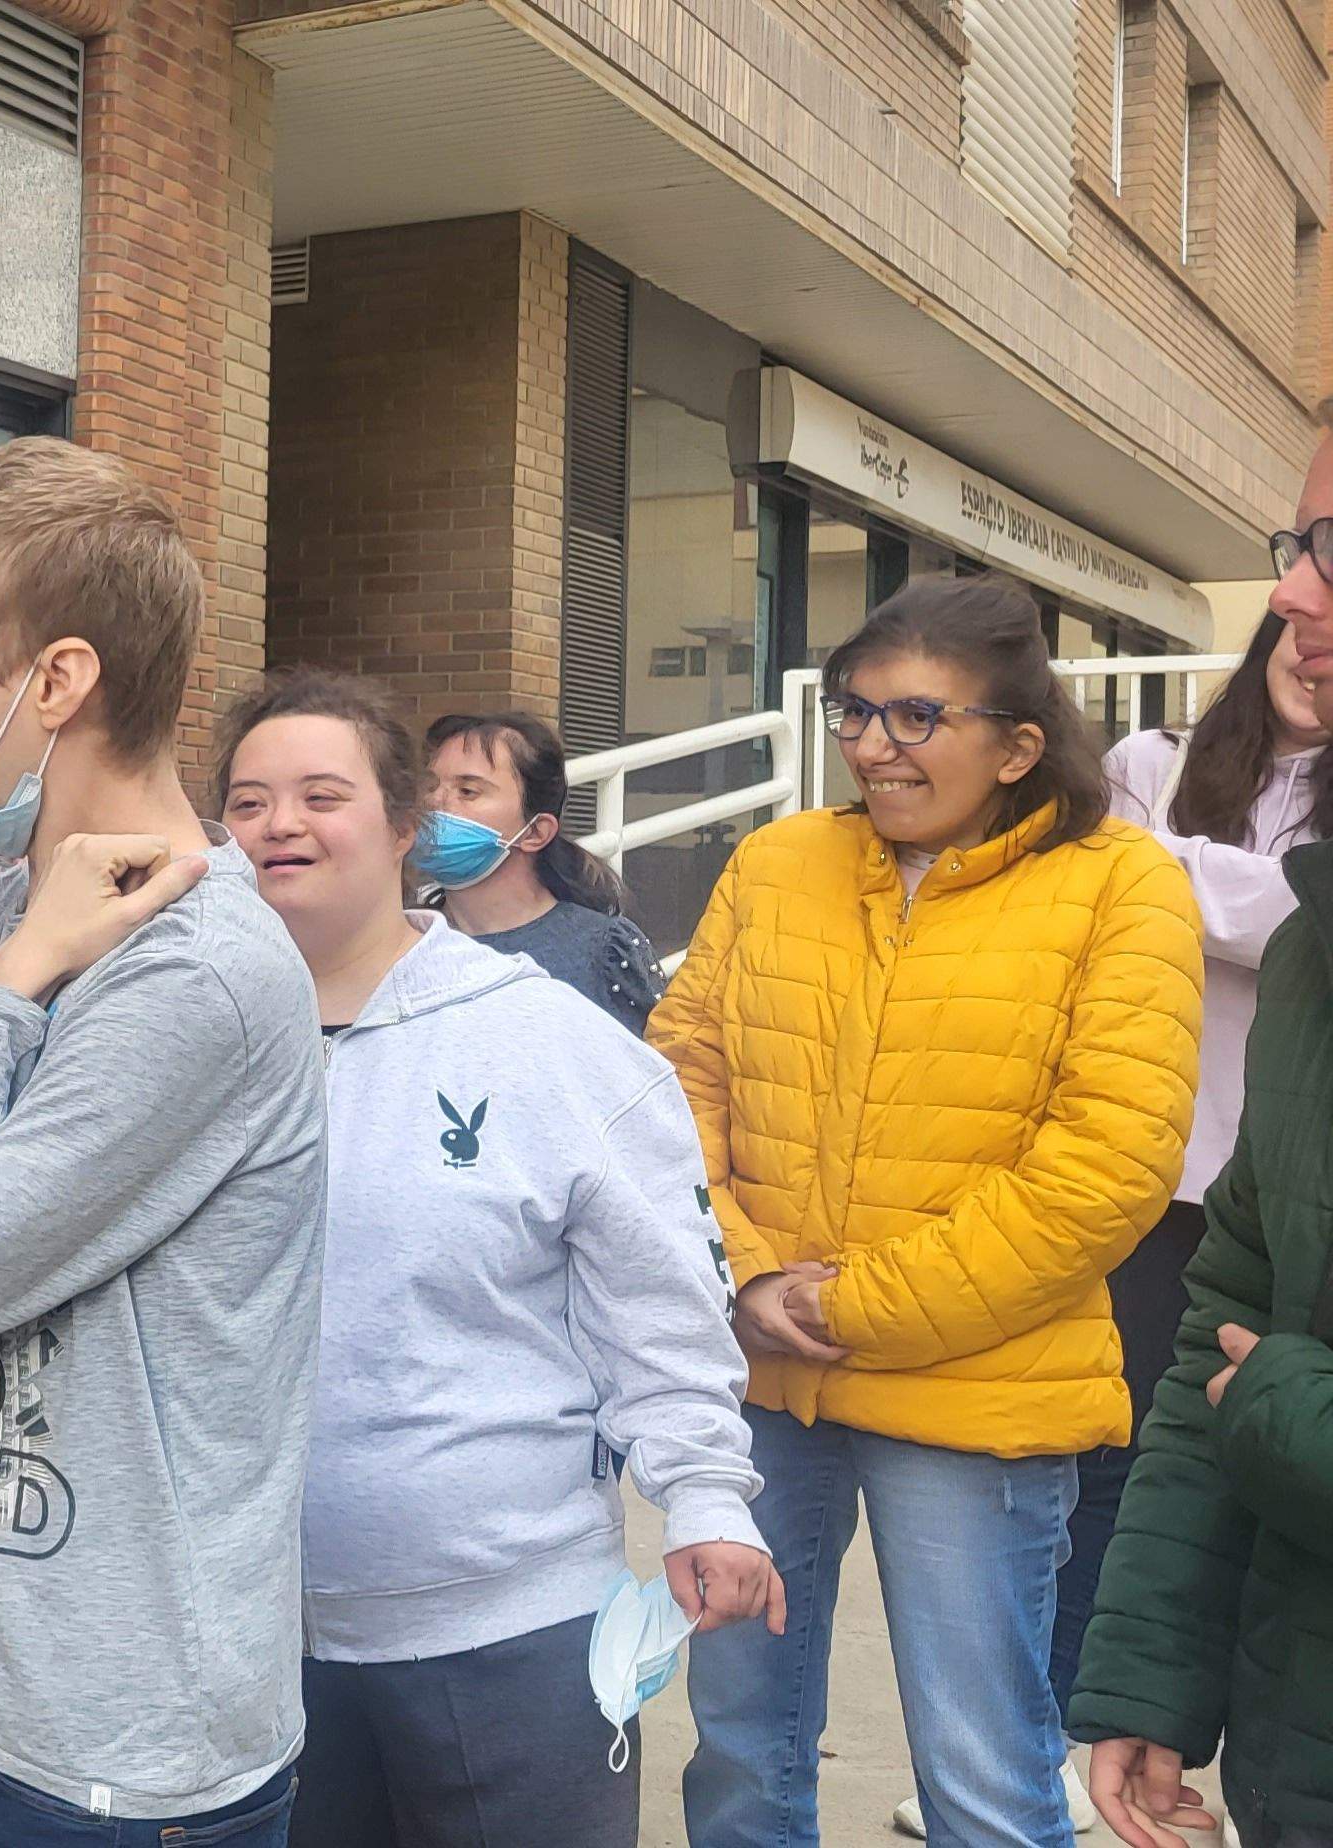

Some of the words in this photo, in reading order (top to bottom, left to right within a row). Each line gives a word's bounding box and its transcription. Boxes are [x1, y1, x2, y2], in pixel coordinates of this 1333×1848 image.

[960, 480, 1006, 535] ESPACIO
[1007, 503, 1049, 558] IBERCAJA
[1050, 528, 1090, 575] CASTILLO
